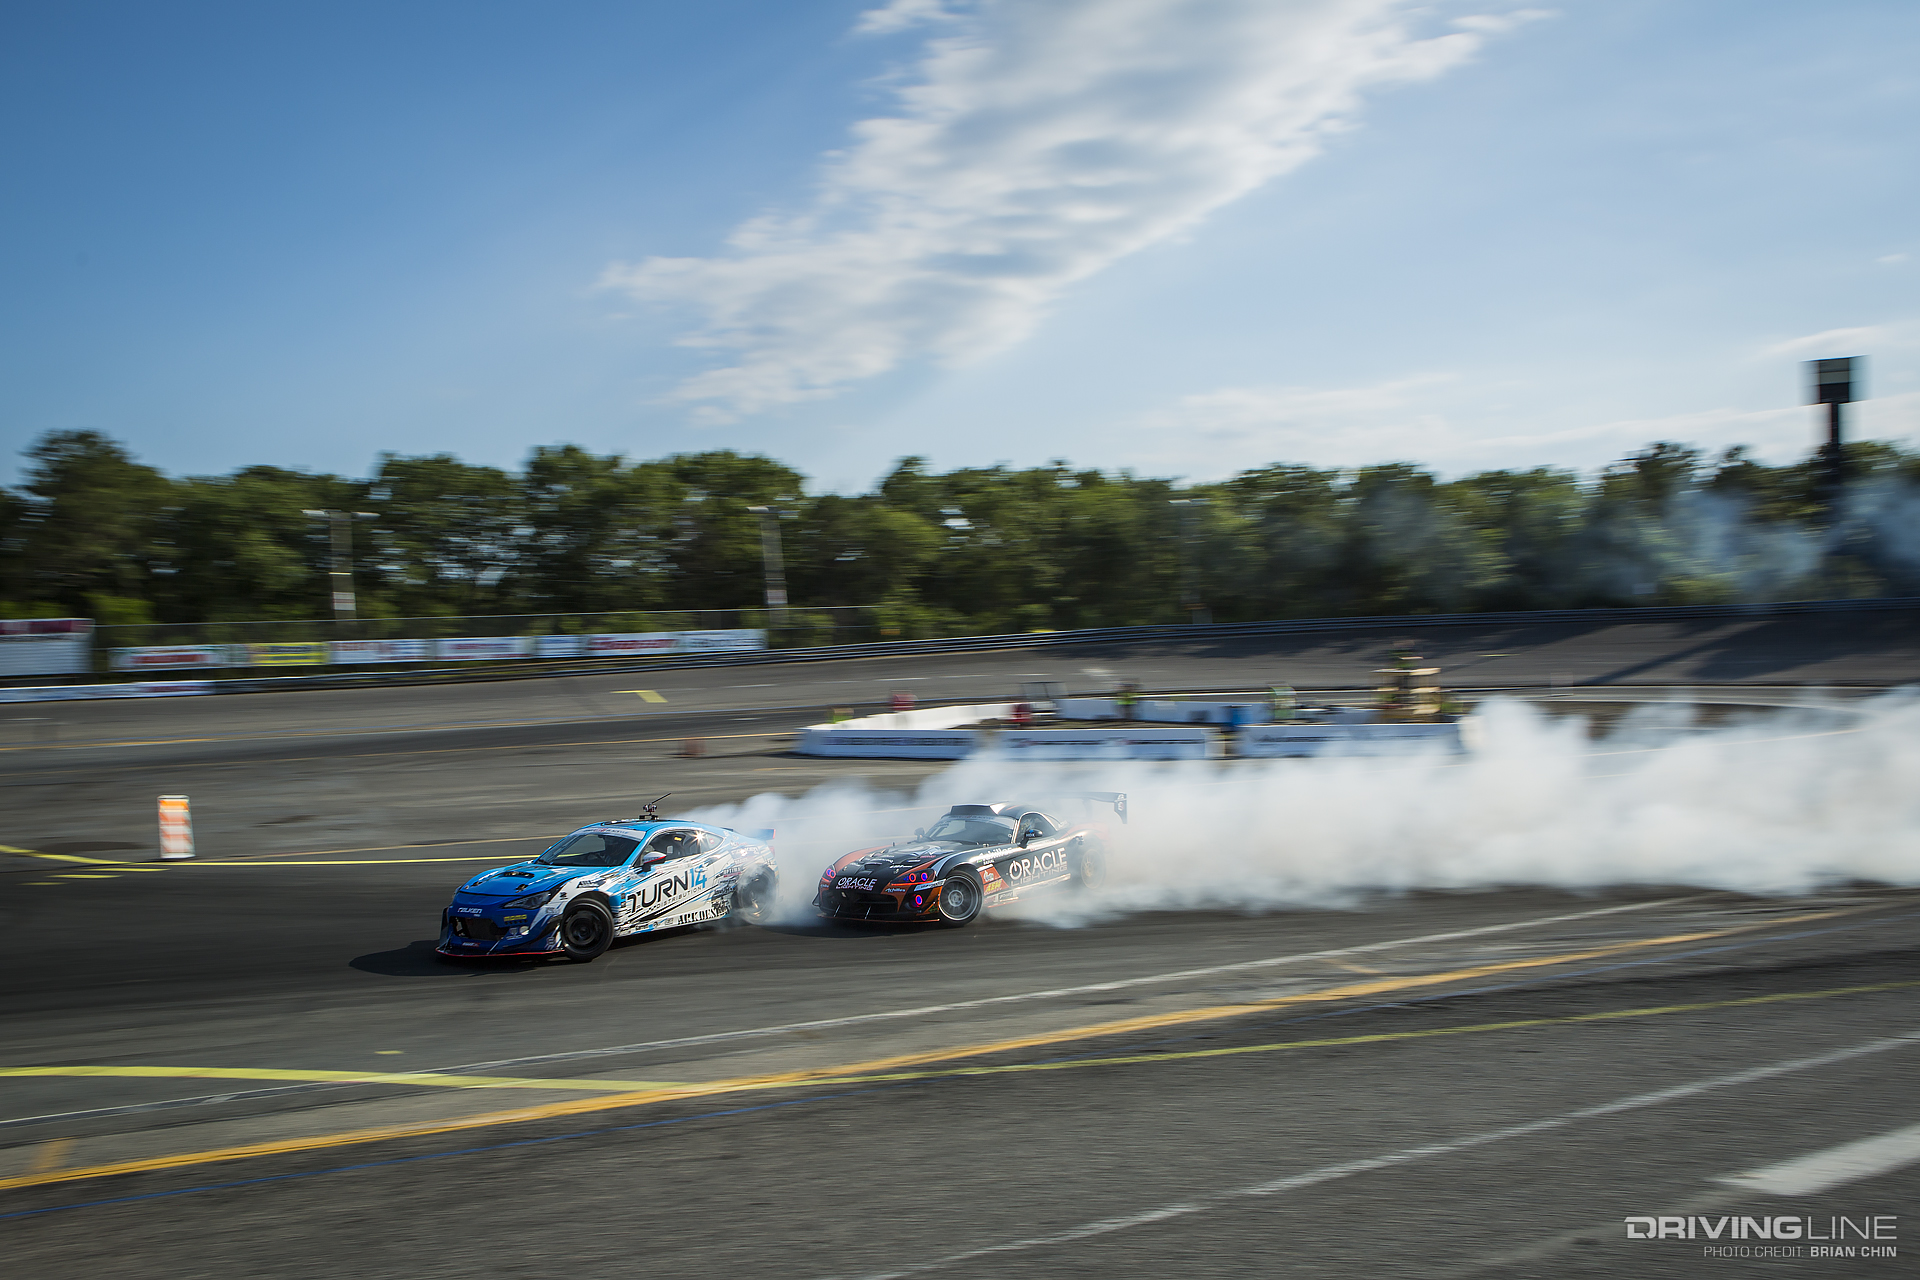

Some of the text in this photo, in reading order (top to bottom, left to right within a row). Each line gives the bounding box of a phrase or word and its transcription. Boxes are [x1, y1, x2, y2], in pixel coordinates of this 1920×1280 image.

[1009, 847, 1067, 880] ORACLE
[837, 877, 878, 888] ORACLE
[1010, 864, 1068, 887] LIGHTING
[656, 886, 702, 909] DISTRIBUTION
